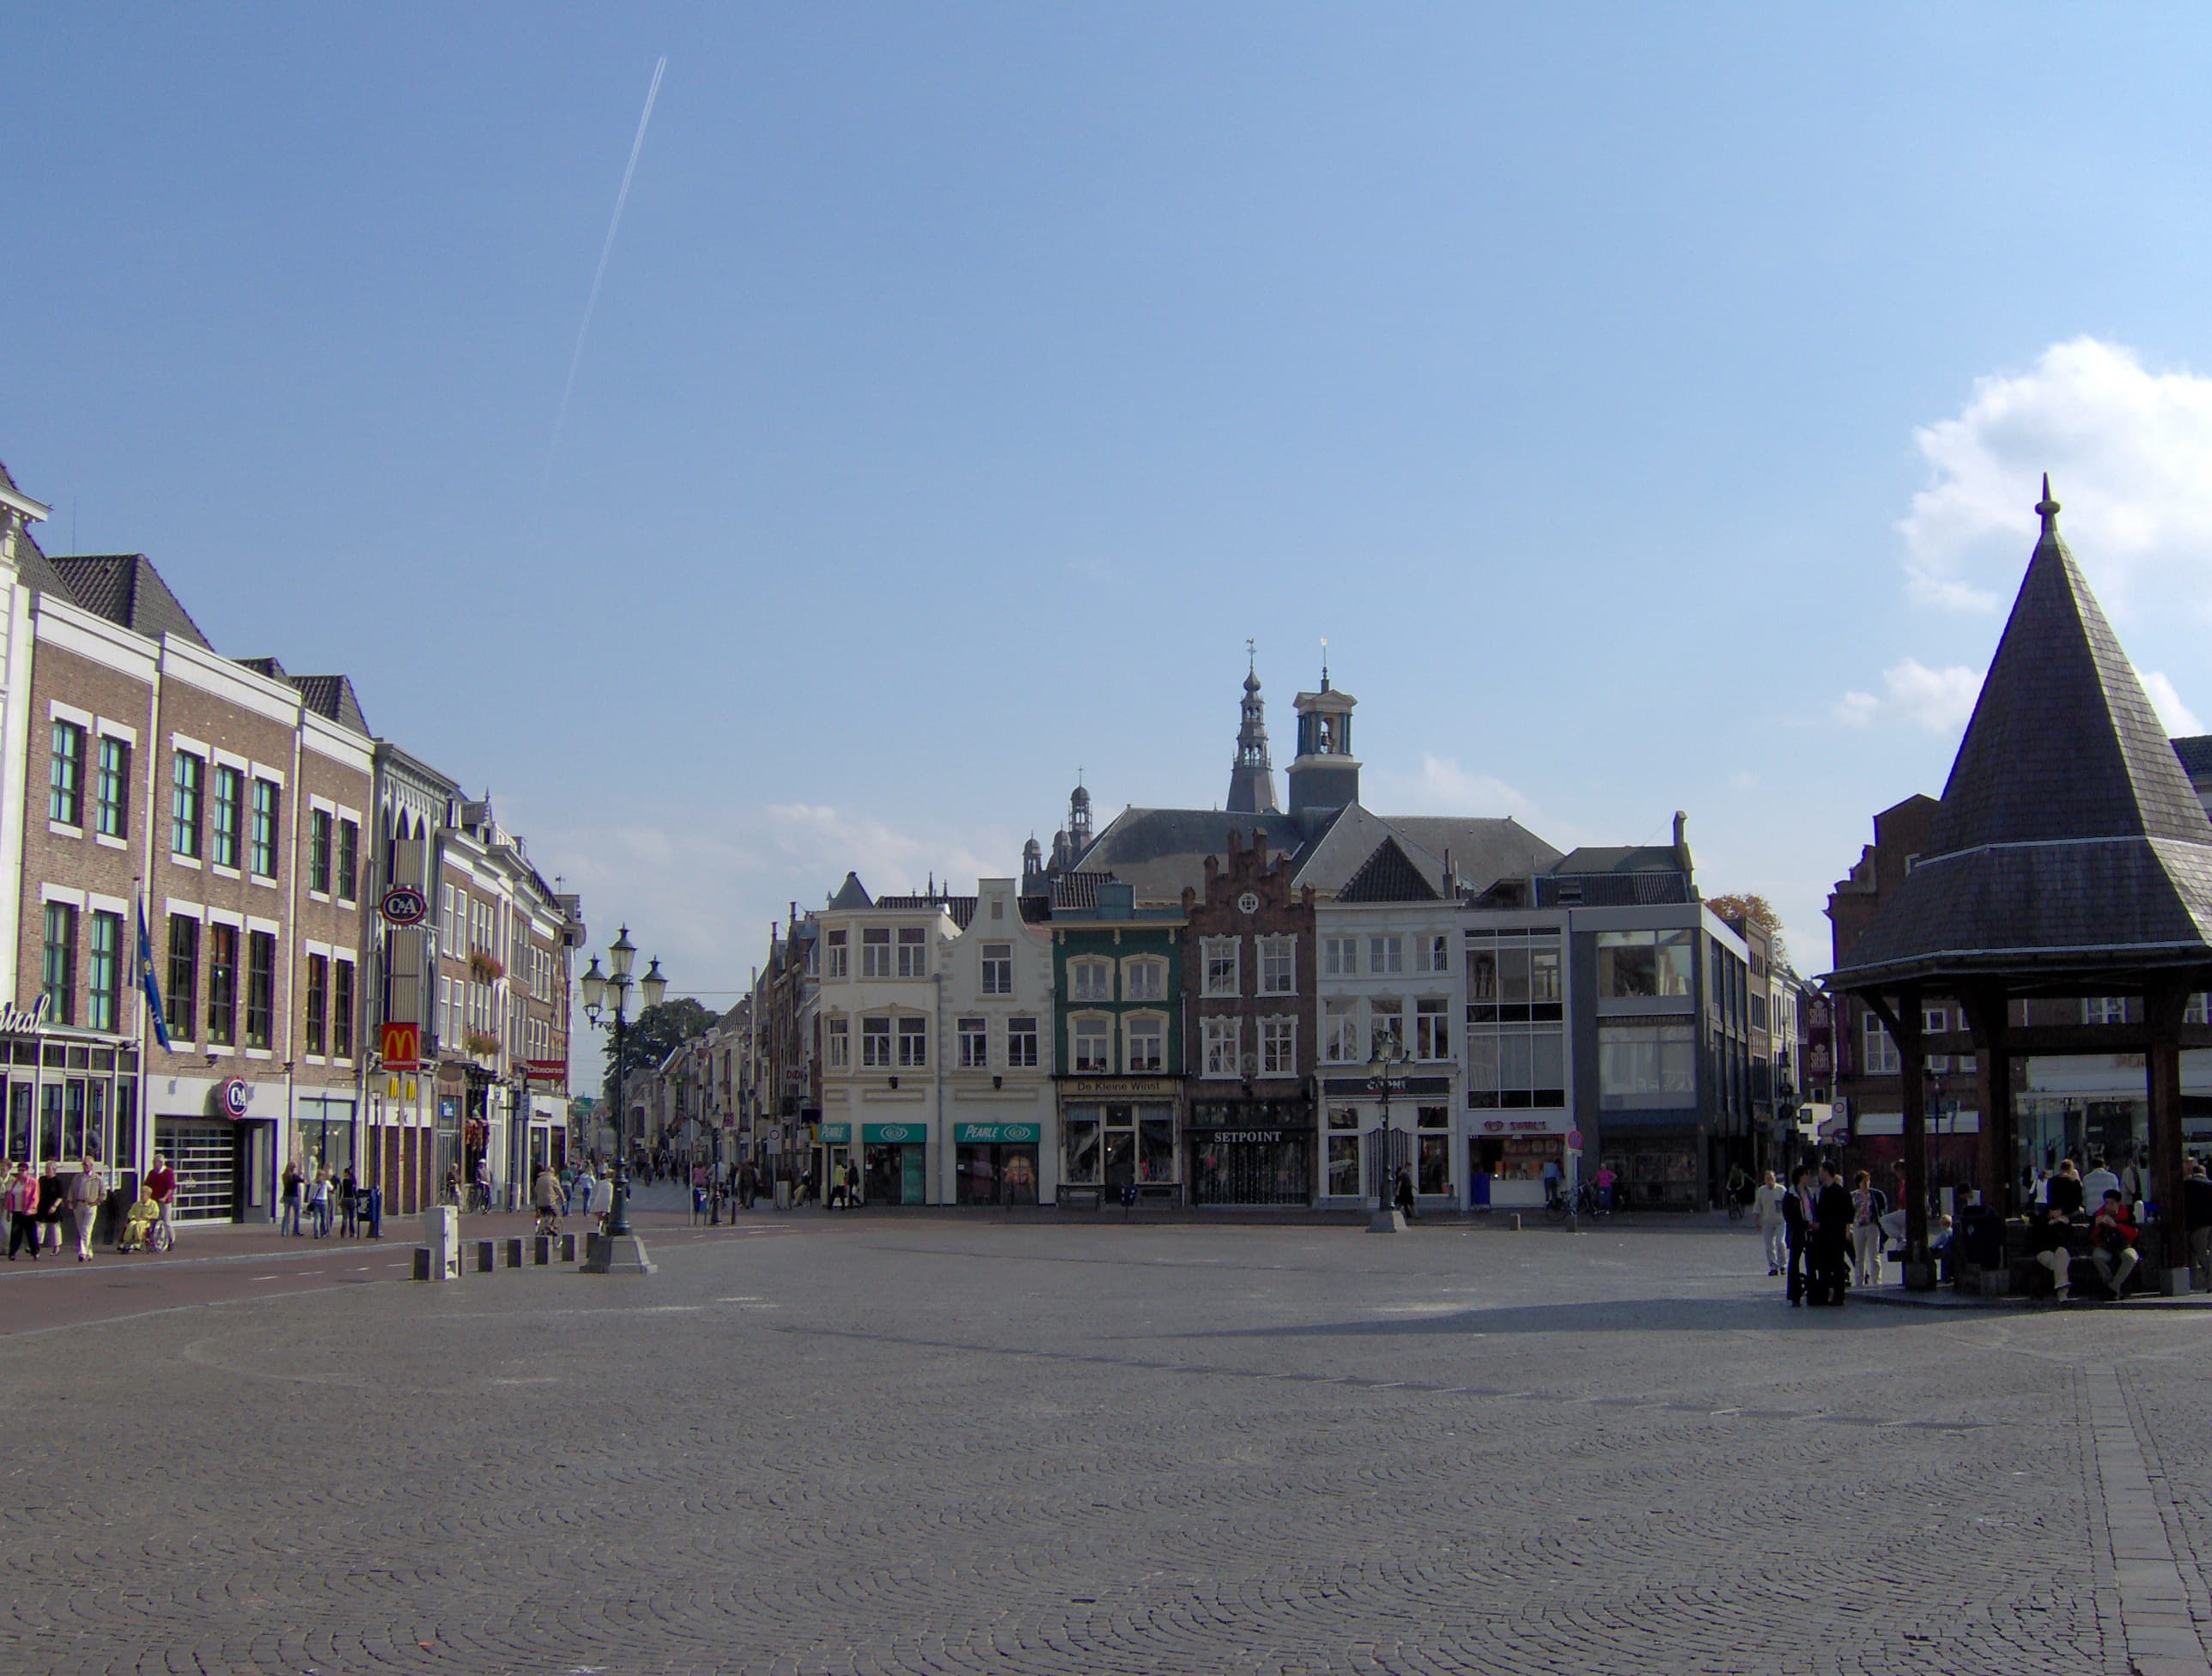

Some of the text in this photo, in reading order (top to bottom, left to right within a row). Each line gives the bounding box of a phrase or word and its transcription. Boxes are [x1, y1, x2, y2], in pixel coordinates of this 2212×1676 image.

[388, 897, 417, 914] C&A
[0, 993, 51, 1034] tral
[527, 1065, 564, 1074] Dixons
[1077, 1081, 1160, 1091] De Kleine Winst
[231, 1087, 247, 1106] C&A
[1213, 1131, 1282, 1143] SETPOINT
